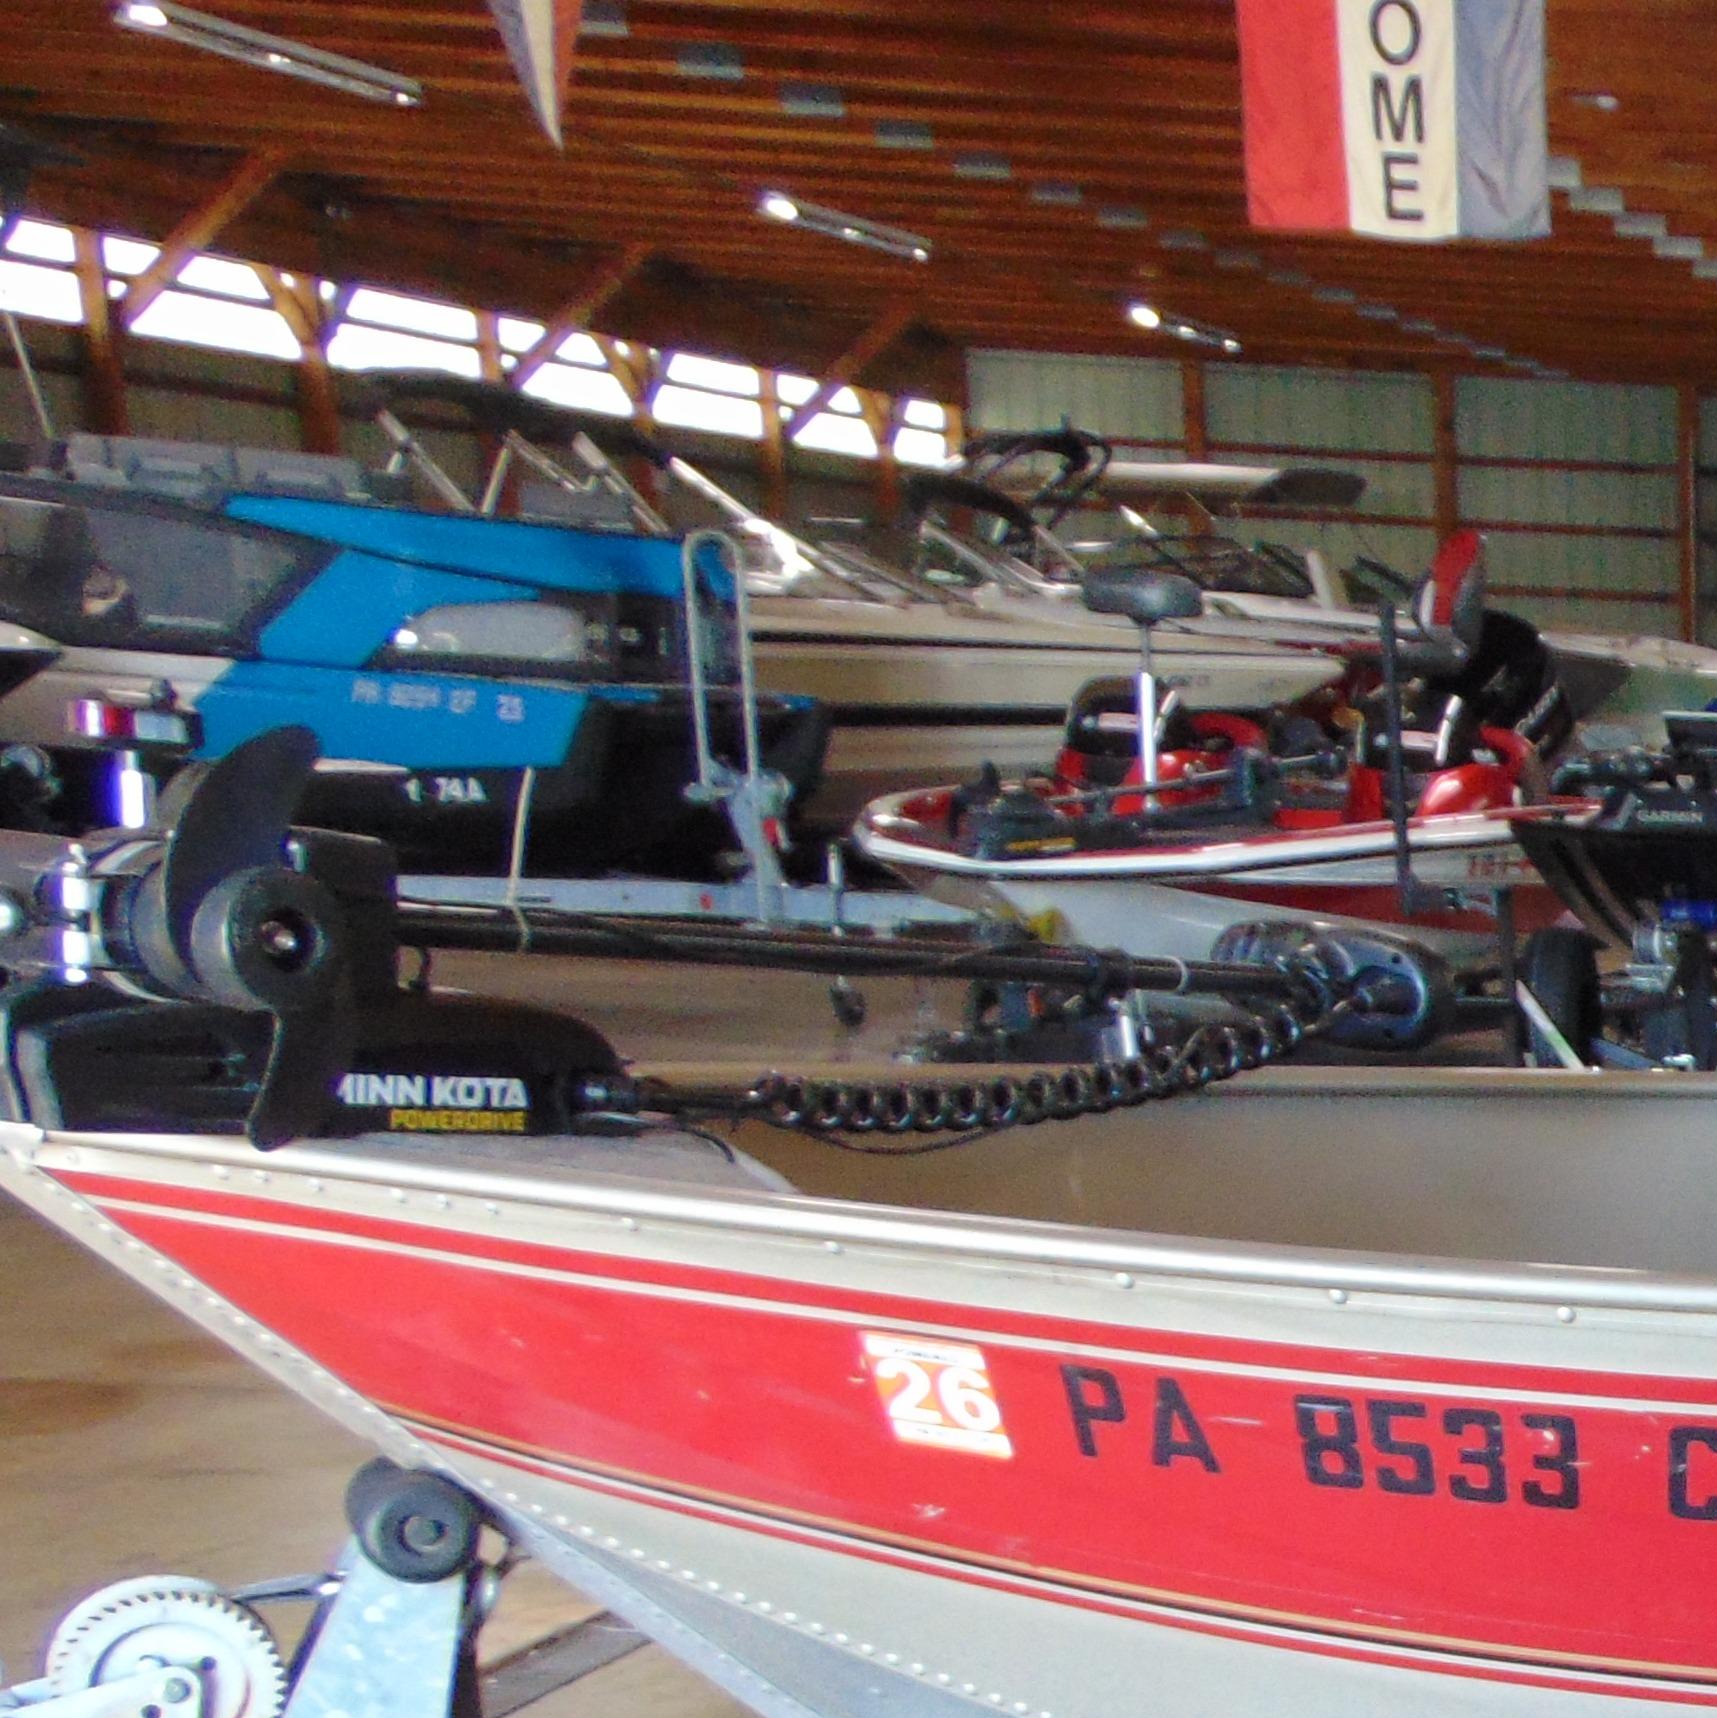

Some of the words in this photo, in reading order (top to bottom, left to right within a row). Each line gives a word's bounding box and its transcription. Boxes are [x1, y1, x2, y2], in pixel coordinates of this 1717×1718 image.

[431, 1074, 529, 1109] KOTA
[875, 1357, 1001, 1433] 26
[1060, 1364, 1222, 1474] PA
[1293, 1393, 1582, 1511] 8533
